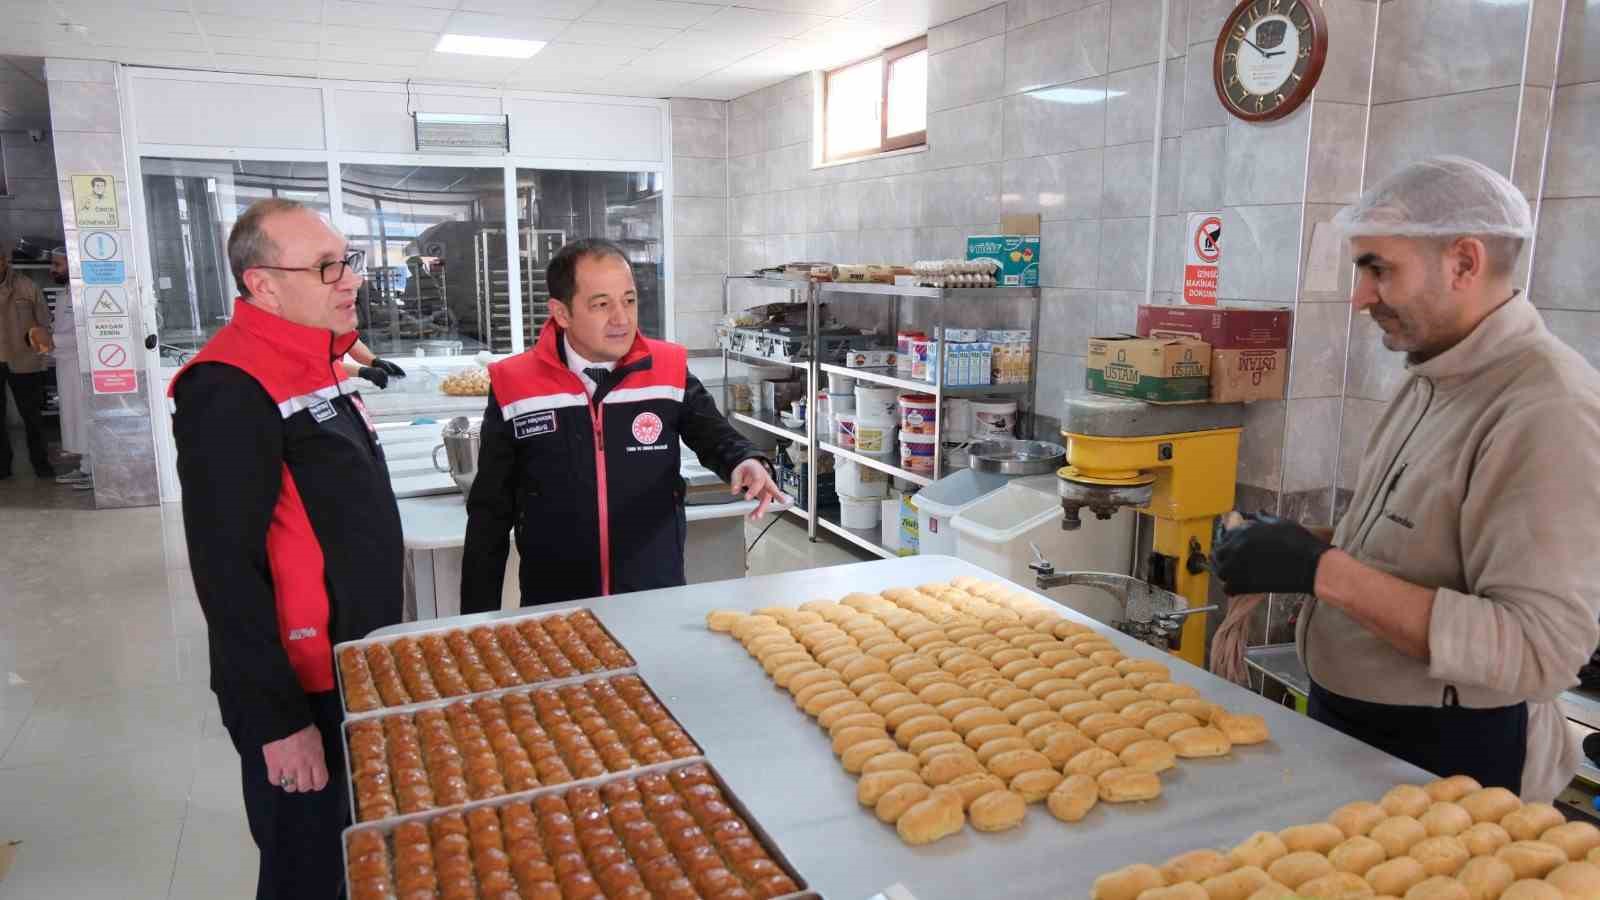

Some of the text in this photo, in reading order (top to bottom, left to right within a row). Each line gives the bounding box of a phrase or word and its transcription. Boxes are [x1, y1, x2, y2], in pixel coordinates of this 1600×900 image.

[1186, 279, 1217, 289] MAKİNAL
[1239, 357, 1276, 370] USTAM
[1105, 366, 1138, 384] USTAM
